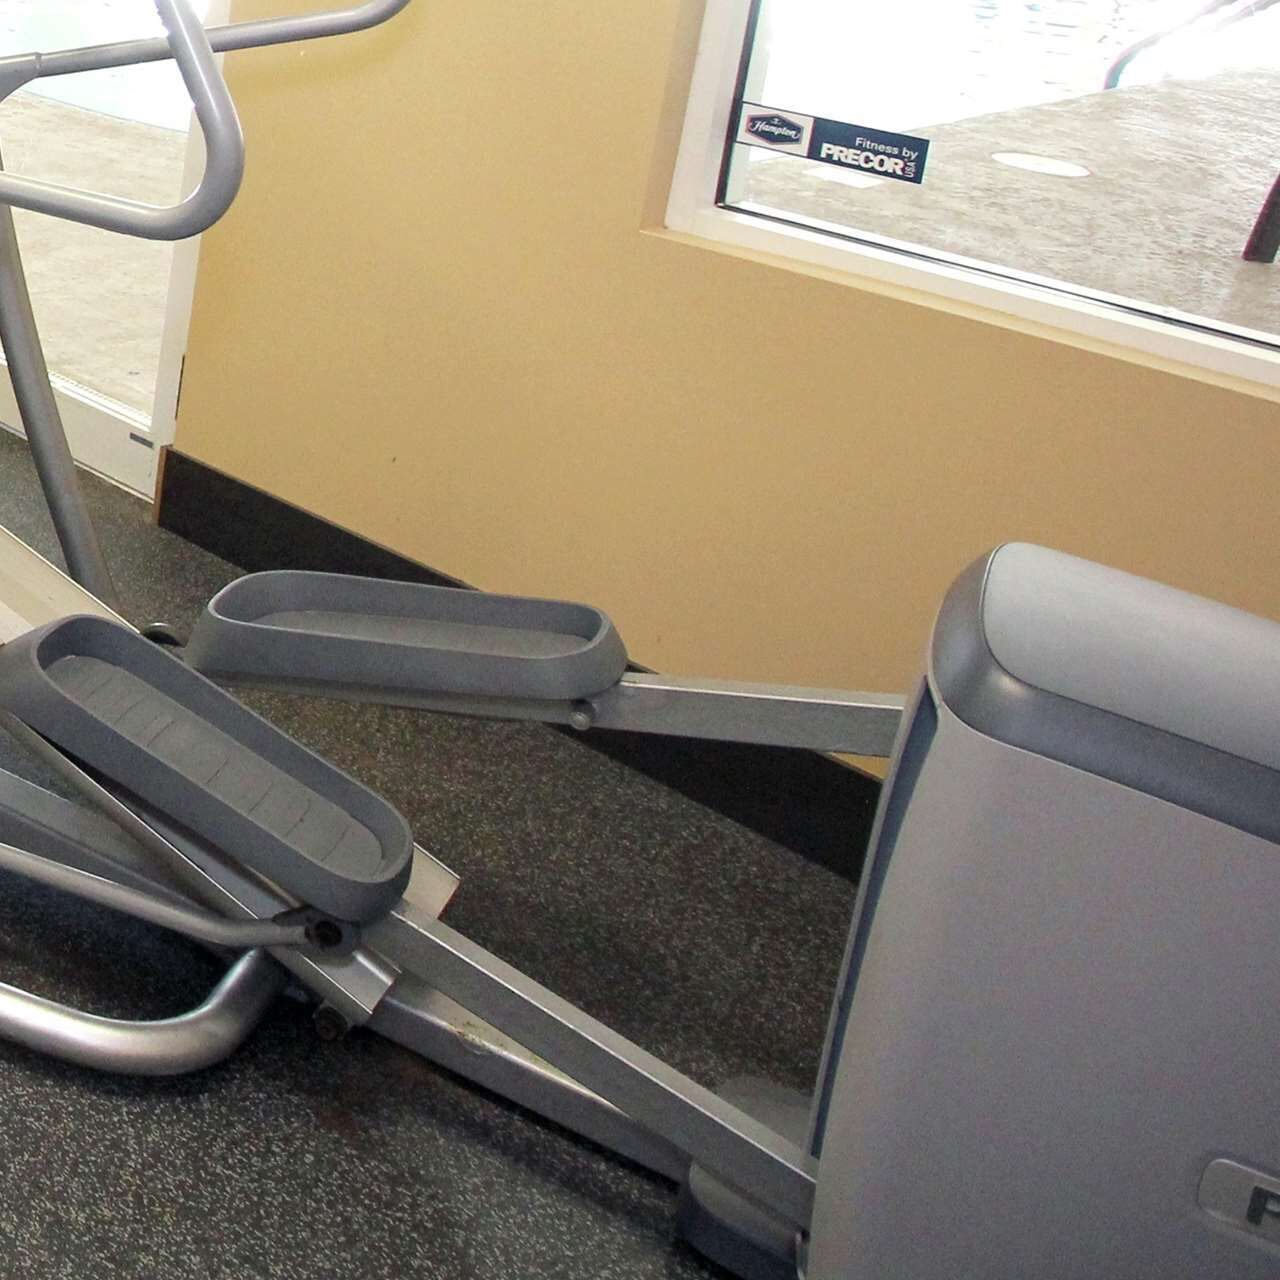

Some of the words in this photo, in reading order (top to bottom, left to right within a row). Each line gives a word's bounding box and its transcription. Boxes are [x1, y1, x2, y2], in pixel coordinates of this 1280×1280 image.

[747, 120, 800, 139] Hampton
[855, 137, 899, 155] Fitness
[902, 147, 918, 159] by
[820, 142, 905, 176] PRECOR
[904, 160, 916, 178] USA
